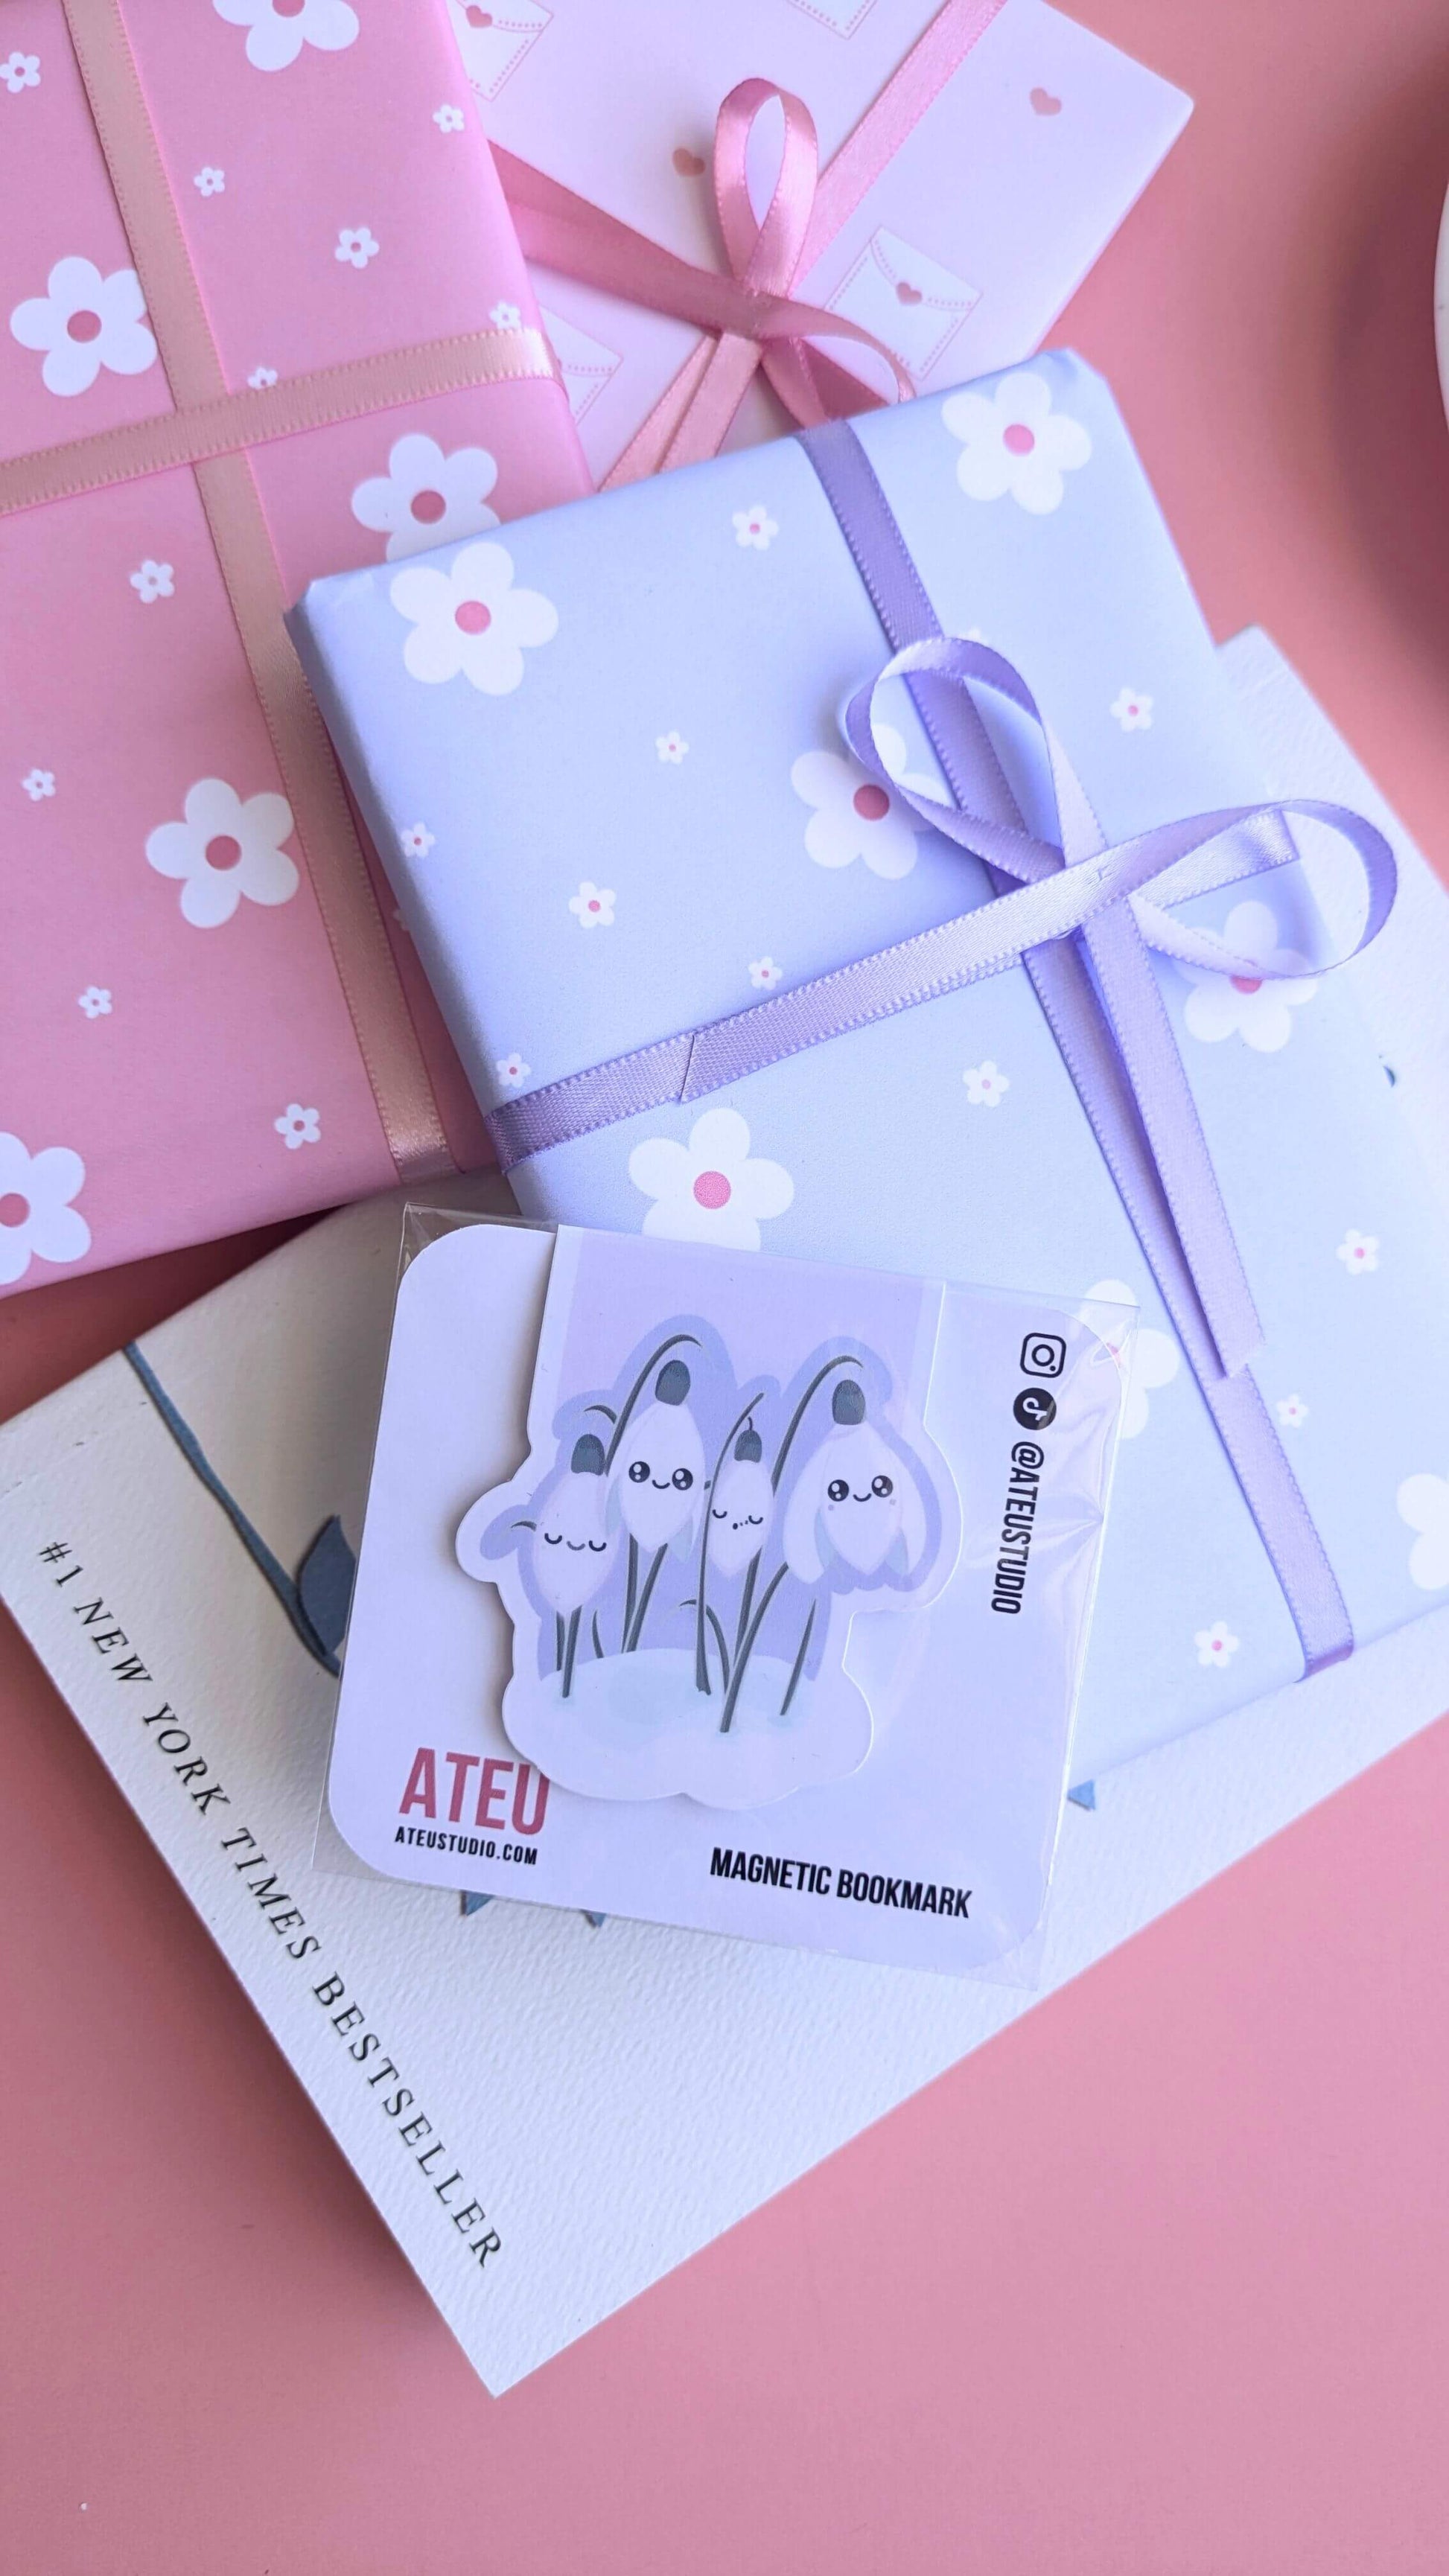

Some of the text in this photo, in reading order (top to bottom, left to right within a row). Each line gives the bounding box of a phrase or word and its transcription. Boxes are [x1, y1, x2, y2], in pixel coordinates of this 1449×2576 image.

[990, 1441, 1045, 1615] @ATEUSTUDIO
[398, 1747, 550, 1835] ATEU
[395, 1826, 538, 1865] ATEUSTUDIO.COM
[710, 1847, 972, 1919] MAGNETIC BOOKMARK
[39, 1541, 503, 2268] #1 NEW YORK TIMES BESTSELLER
